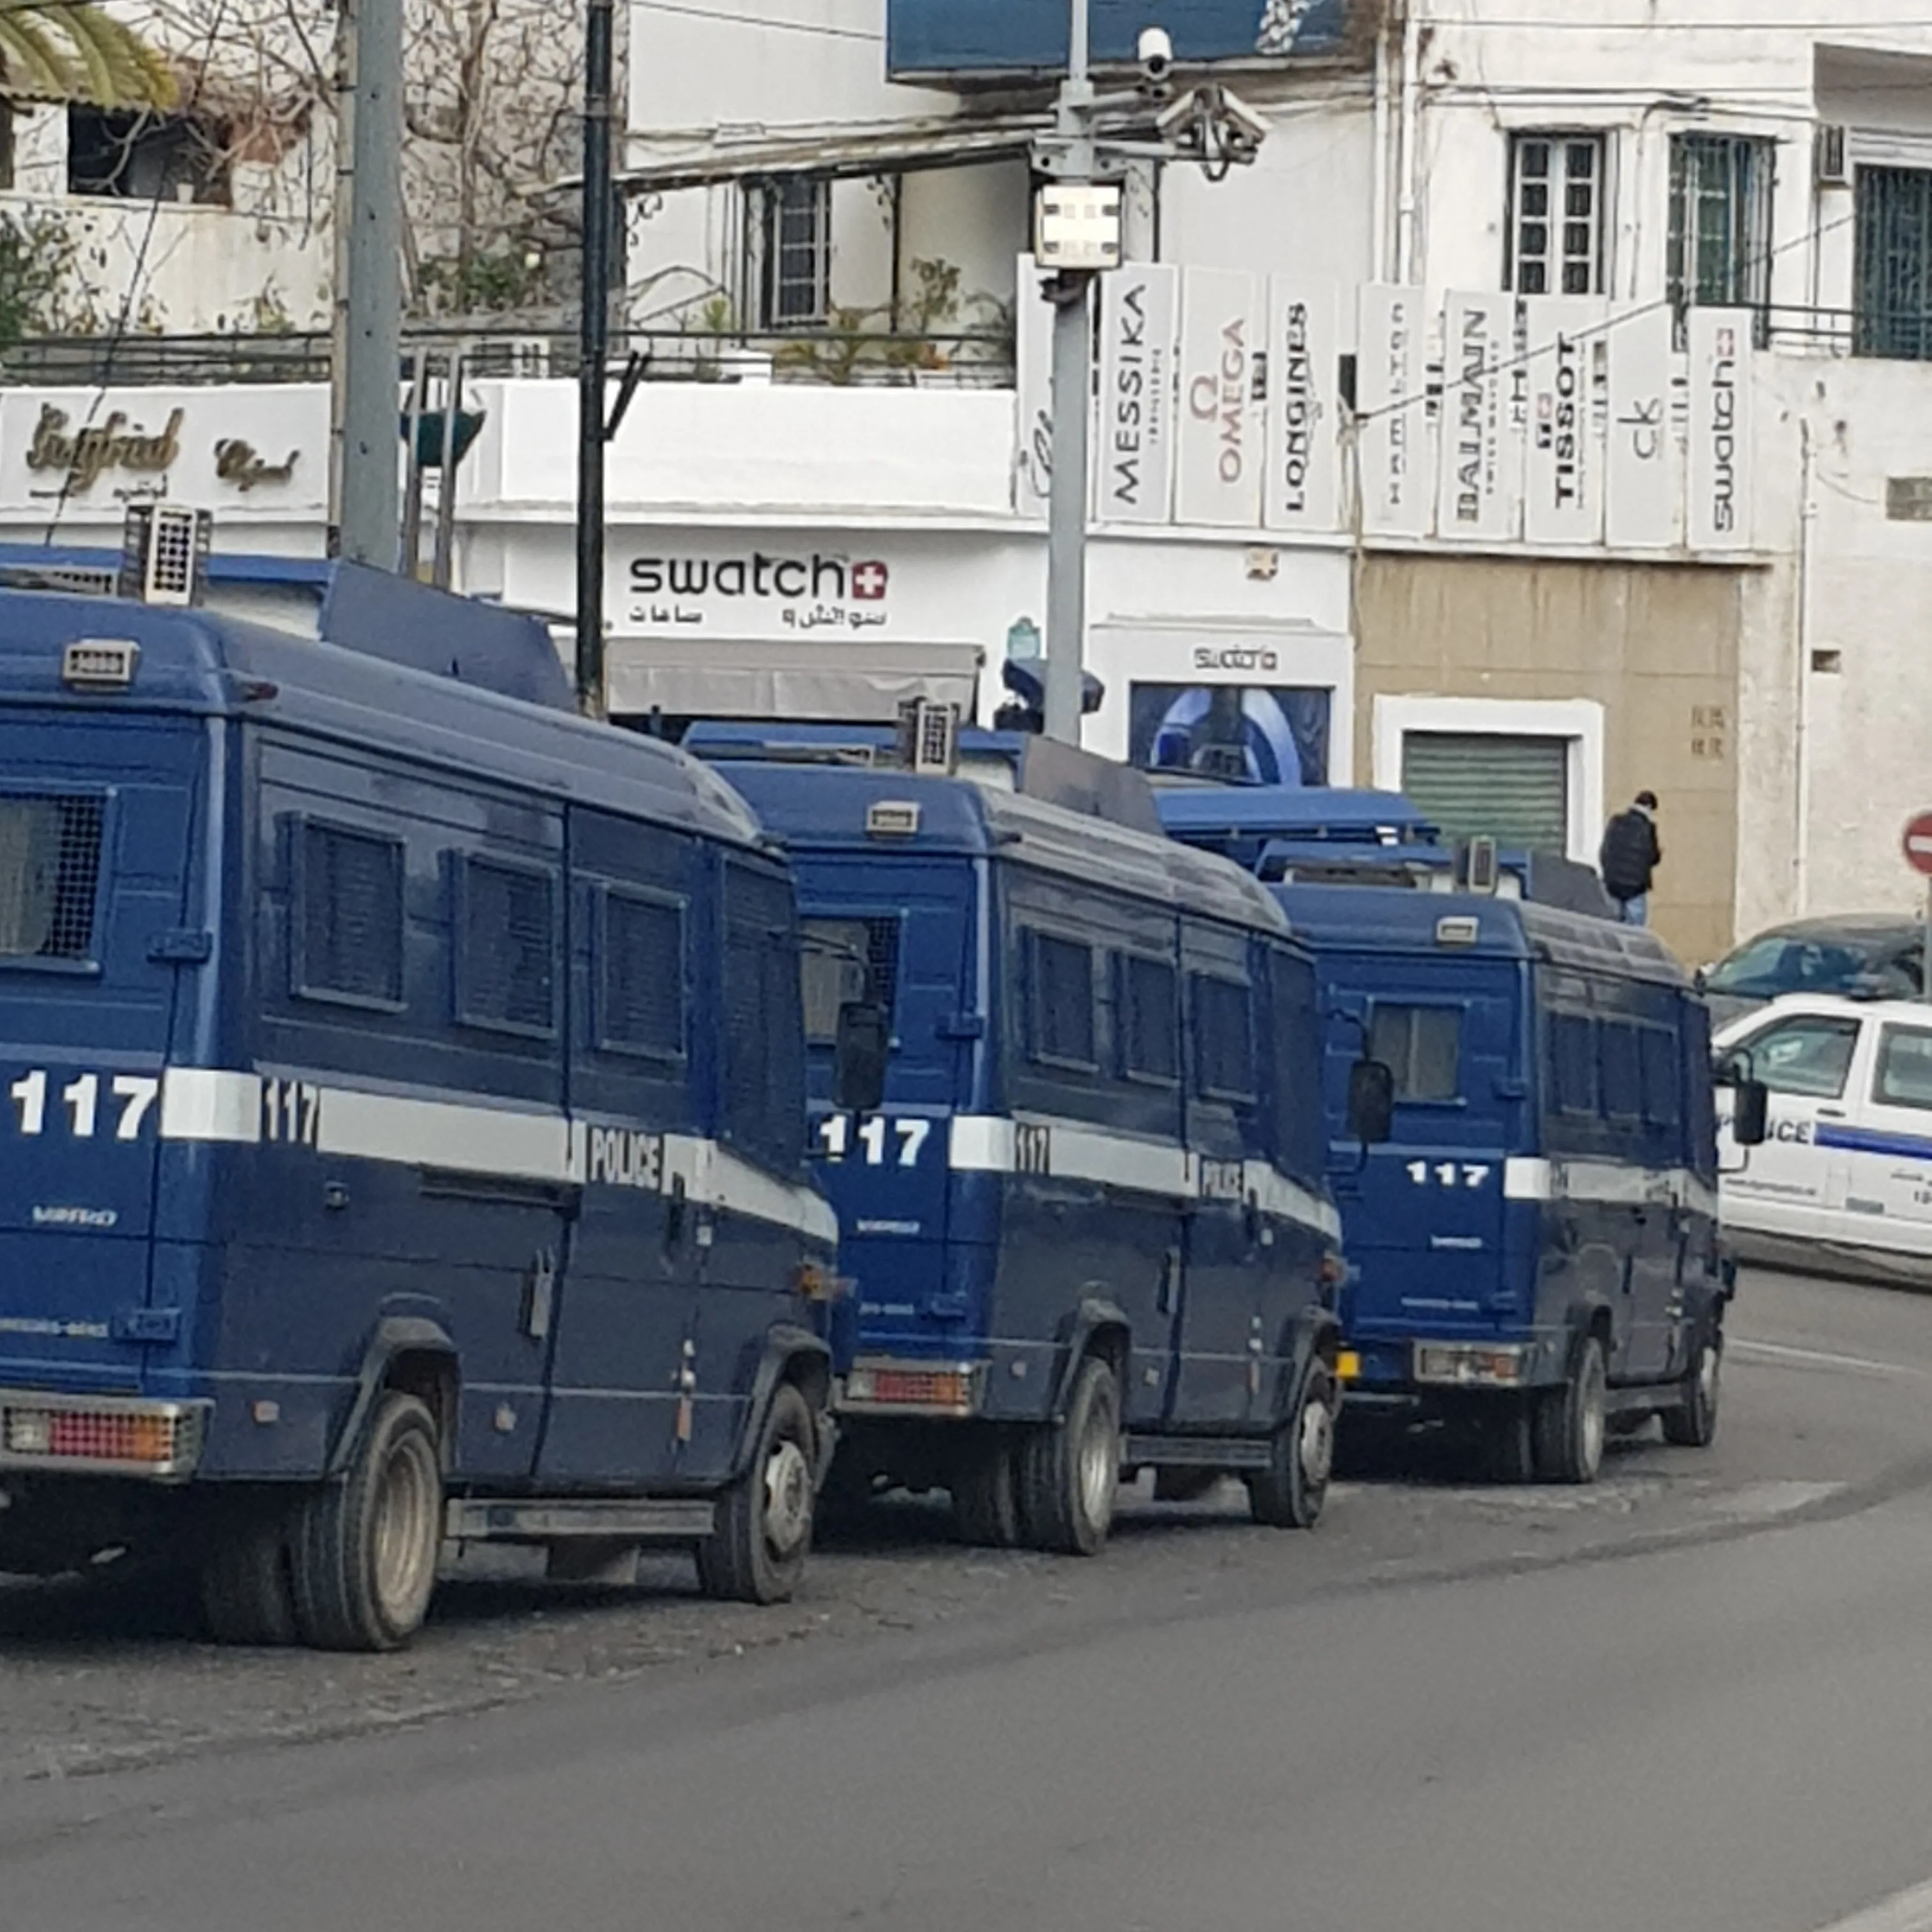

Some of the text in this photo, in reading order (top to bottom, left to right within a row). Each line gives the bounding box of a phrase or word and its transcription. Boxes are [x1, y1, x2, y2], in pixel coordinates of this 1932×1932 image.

[1114, 284, 1146, 504] MESSIKA
[1219, 319, 1245, 484] OMEGA
[1285, 302, 1306, 512] LONGINES
[1456, 309, 1486, 523] BALMAIN
[1555, 332, 1575, 510] TISSOT
[1712, 359, 1734, 532] swatch
[629, 552, 845, 599] swatch
[12, 1070, 158, 1139] 117
[266, 1076, 317, 1144] 117
[591, 1127, 659, 1190] POLICE
[820, 1114, 930, 1166] 117
[1406, 1160, 1489, 1187] 117
